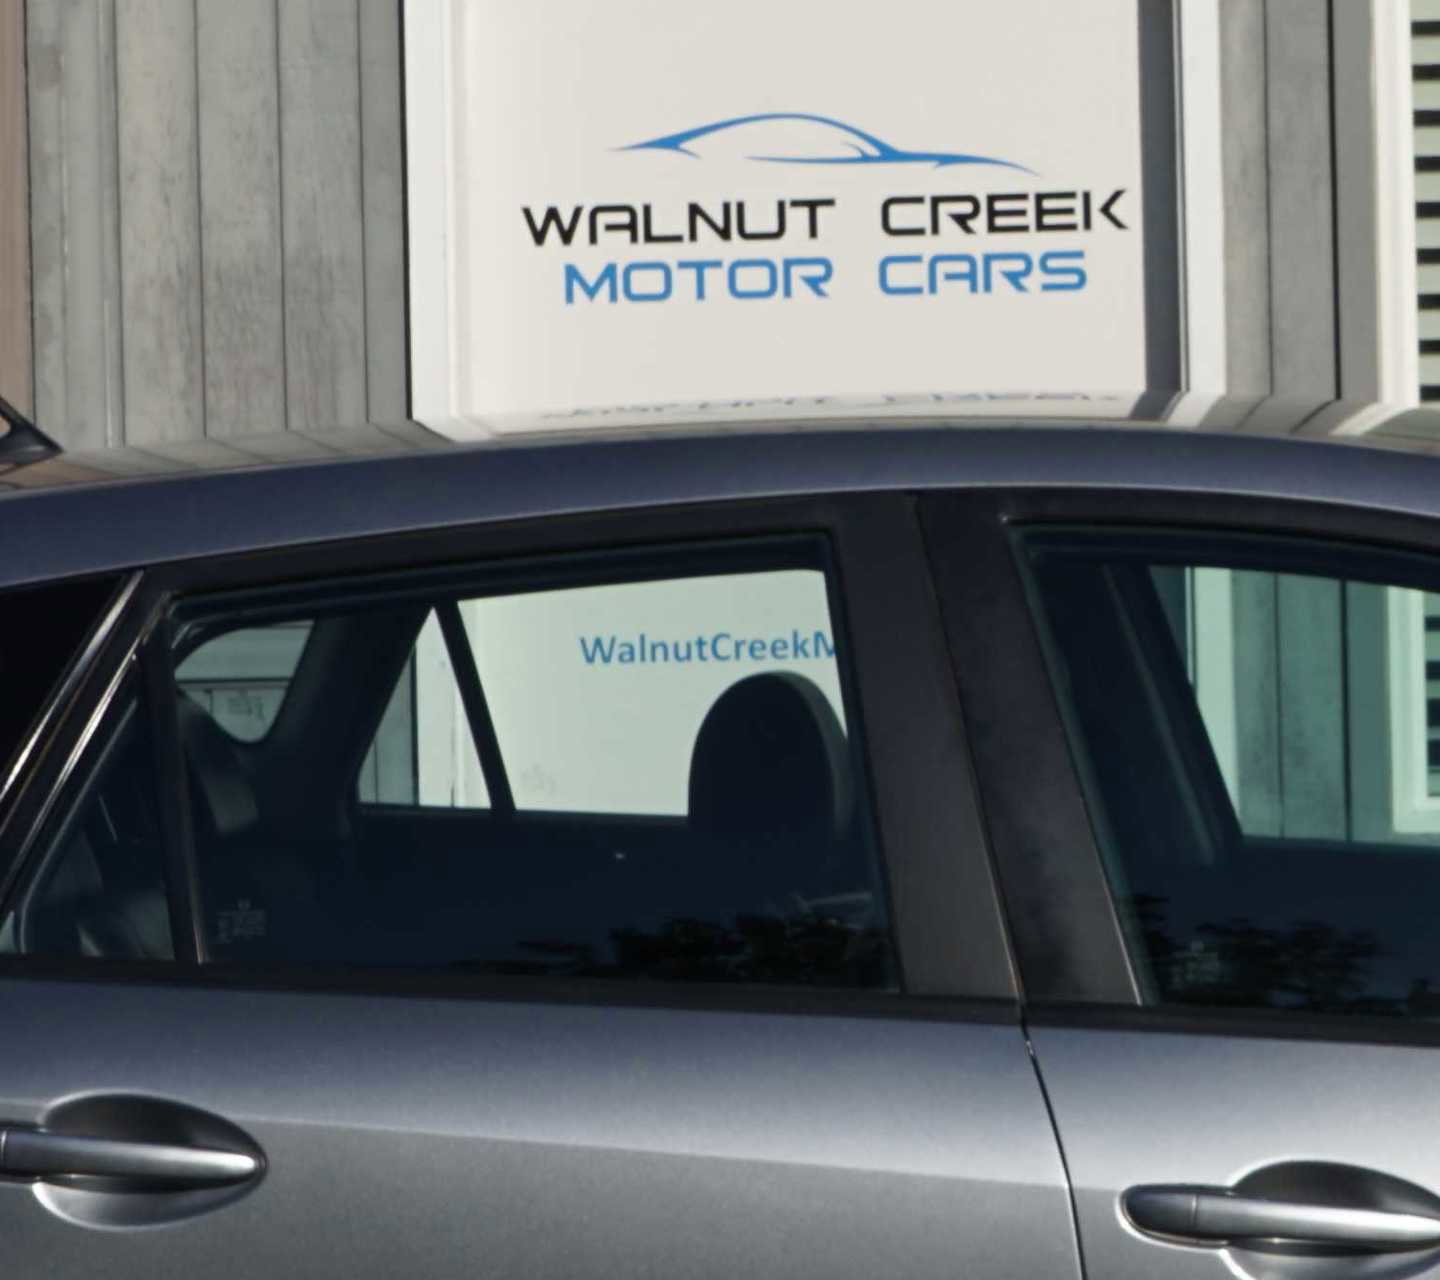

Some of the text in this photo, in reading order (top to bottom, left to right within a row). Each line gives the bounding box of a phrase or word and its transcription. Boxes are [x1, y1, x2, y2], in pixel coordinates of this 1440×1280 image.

[523, 190, 1126, 246] WALNUT CREEK
[564, 250, 1088, 305] MOTOR CARS
